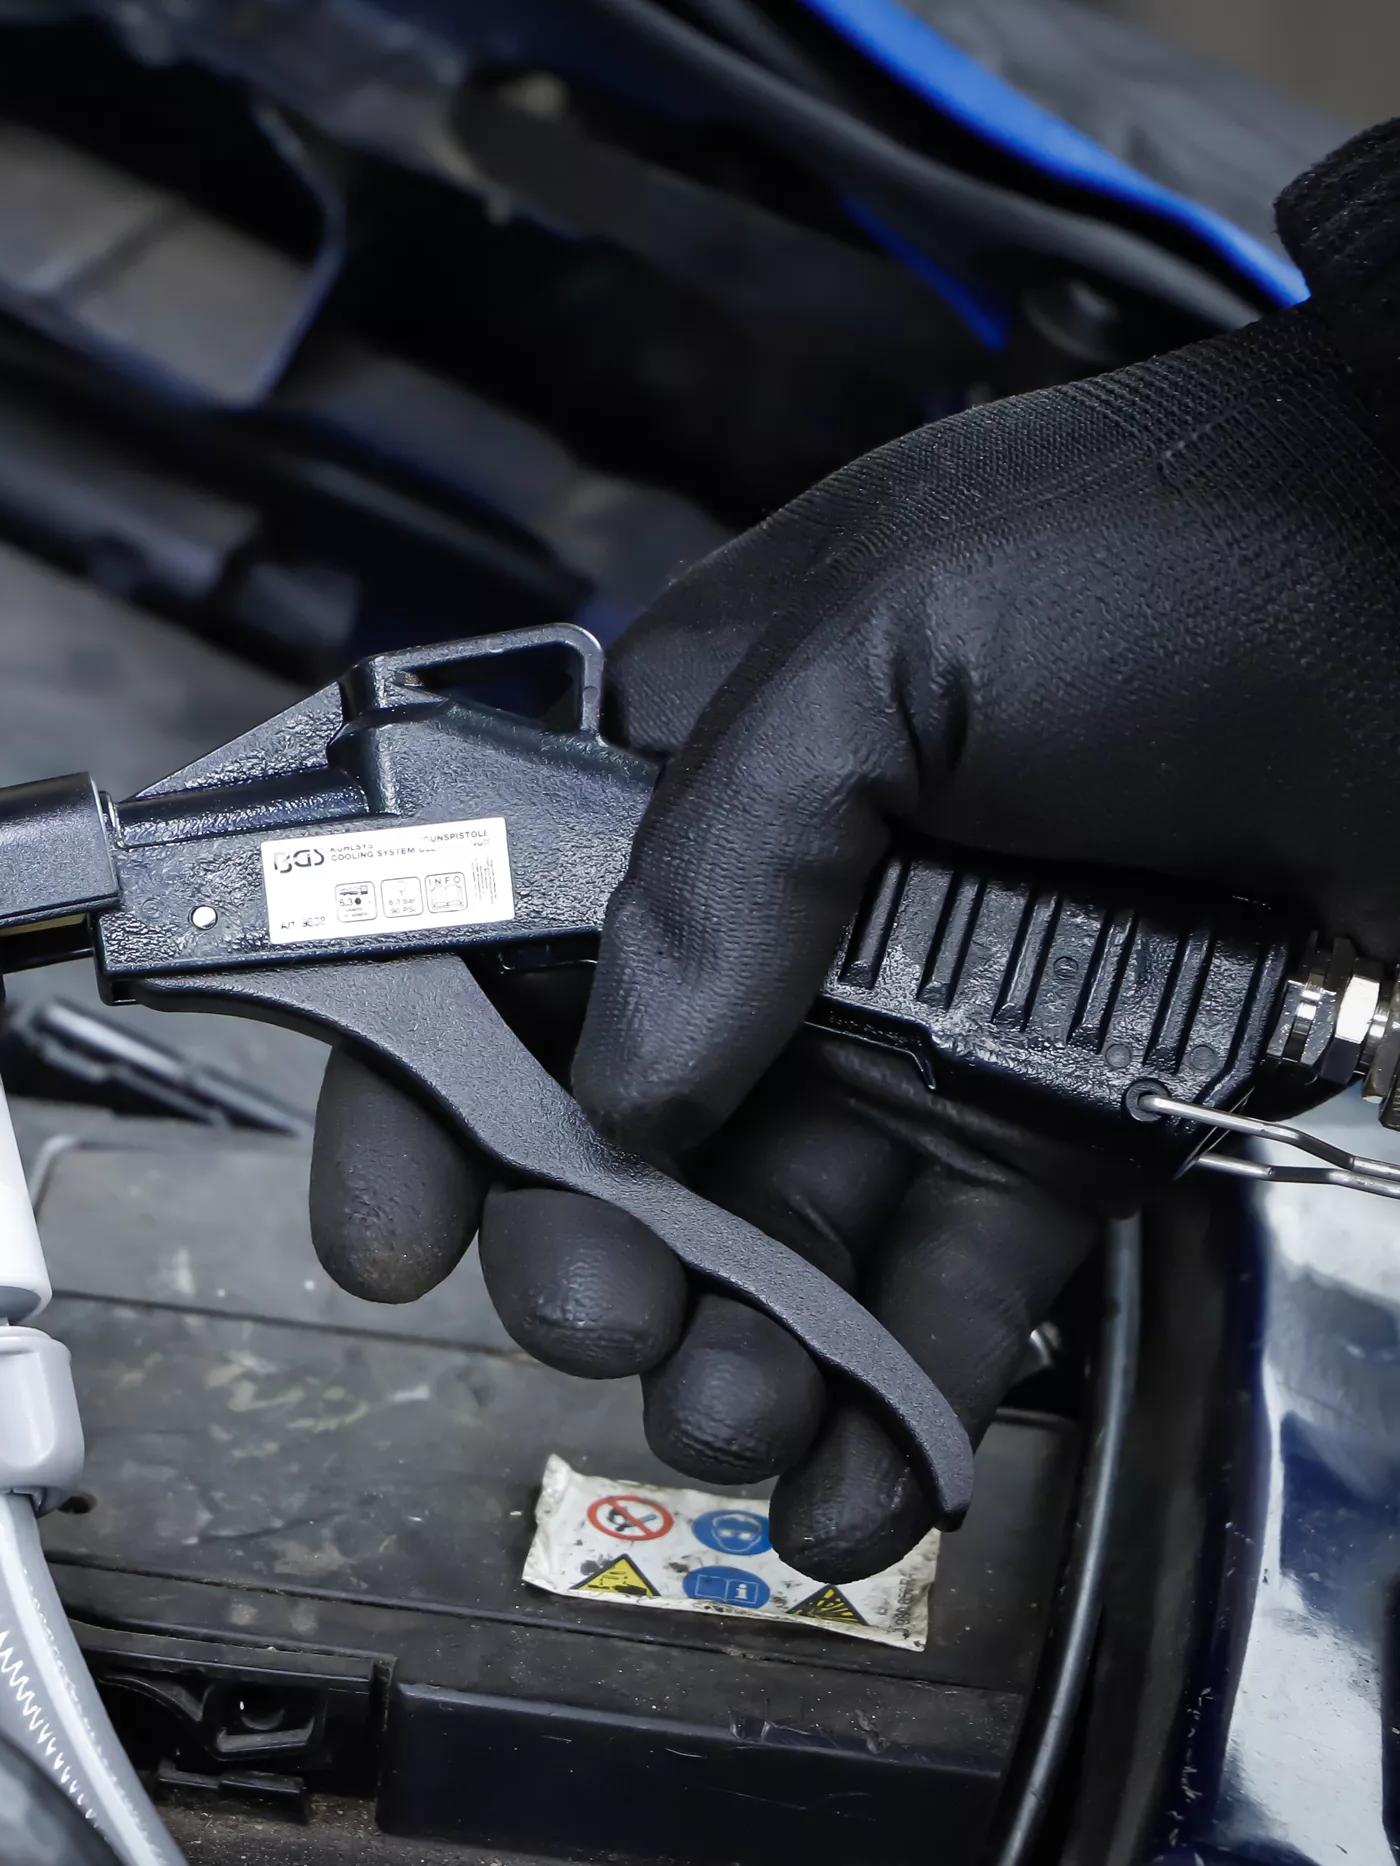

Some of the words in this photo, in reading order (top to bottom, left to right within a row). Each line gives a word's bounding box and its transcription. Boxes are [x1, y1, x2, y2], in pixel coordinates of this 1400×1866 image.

[331, 850, 374, 863] COOLING
[377, 846, 416, 858] SYSTEM
[429, 875, 461, 886] INFO
